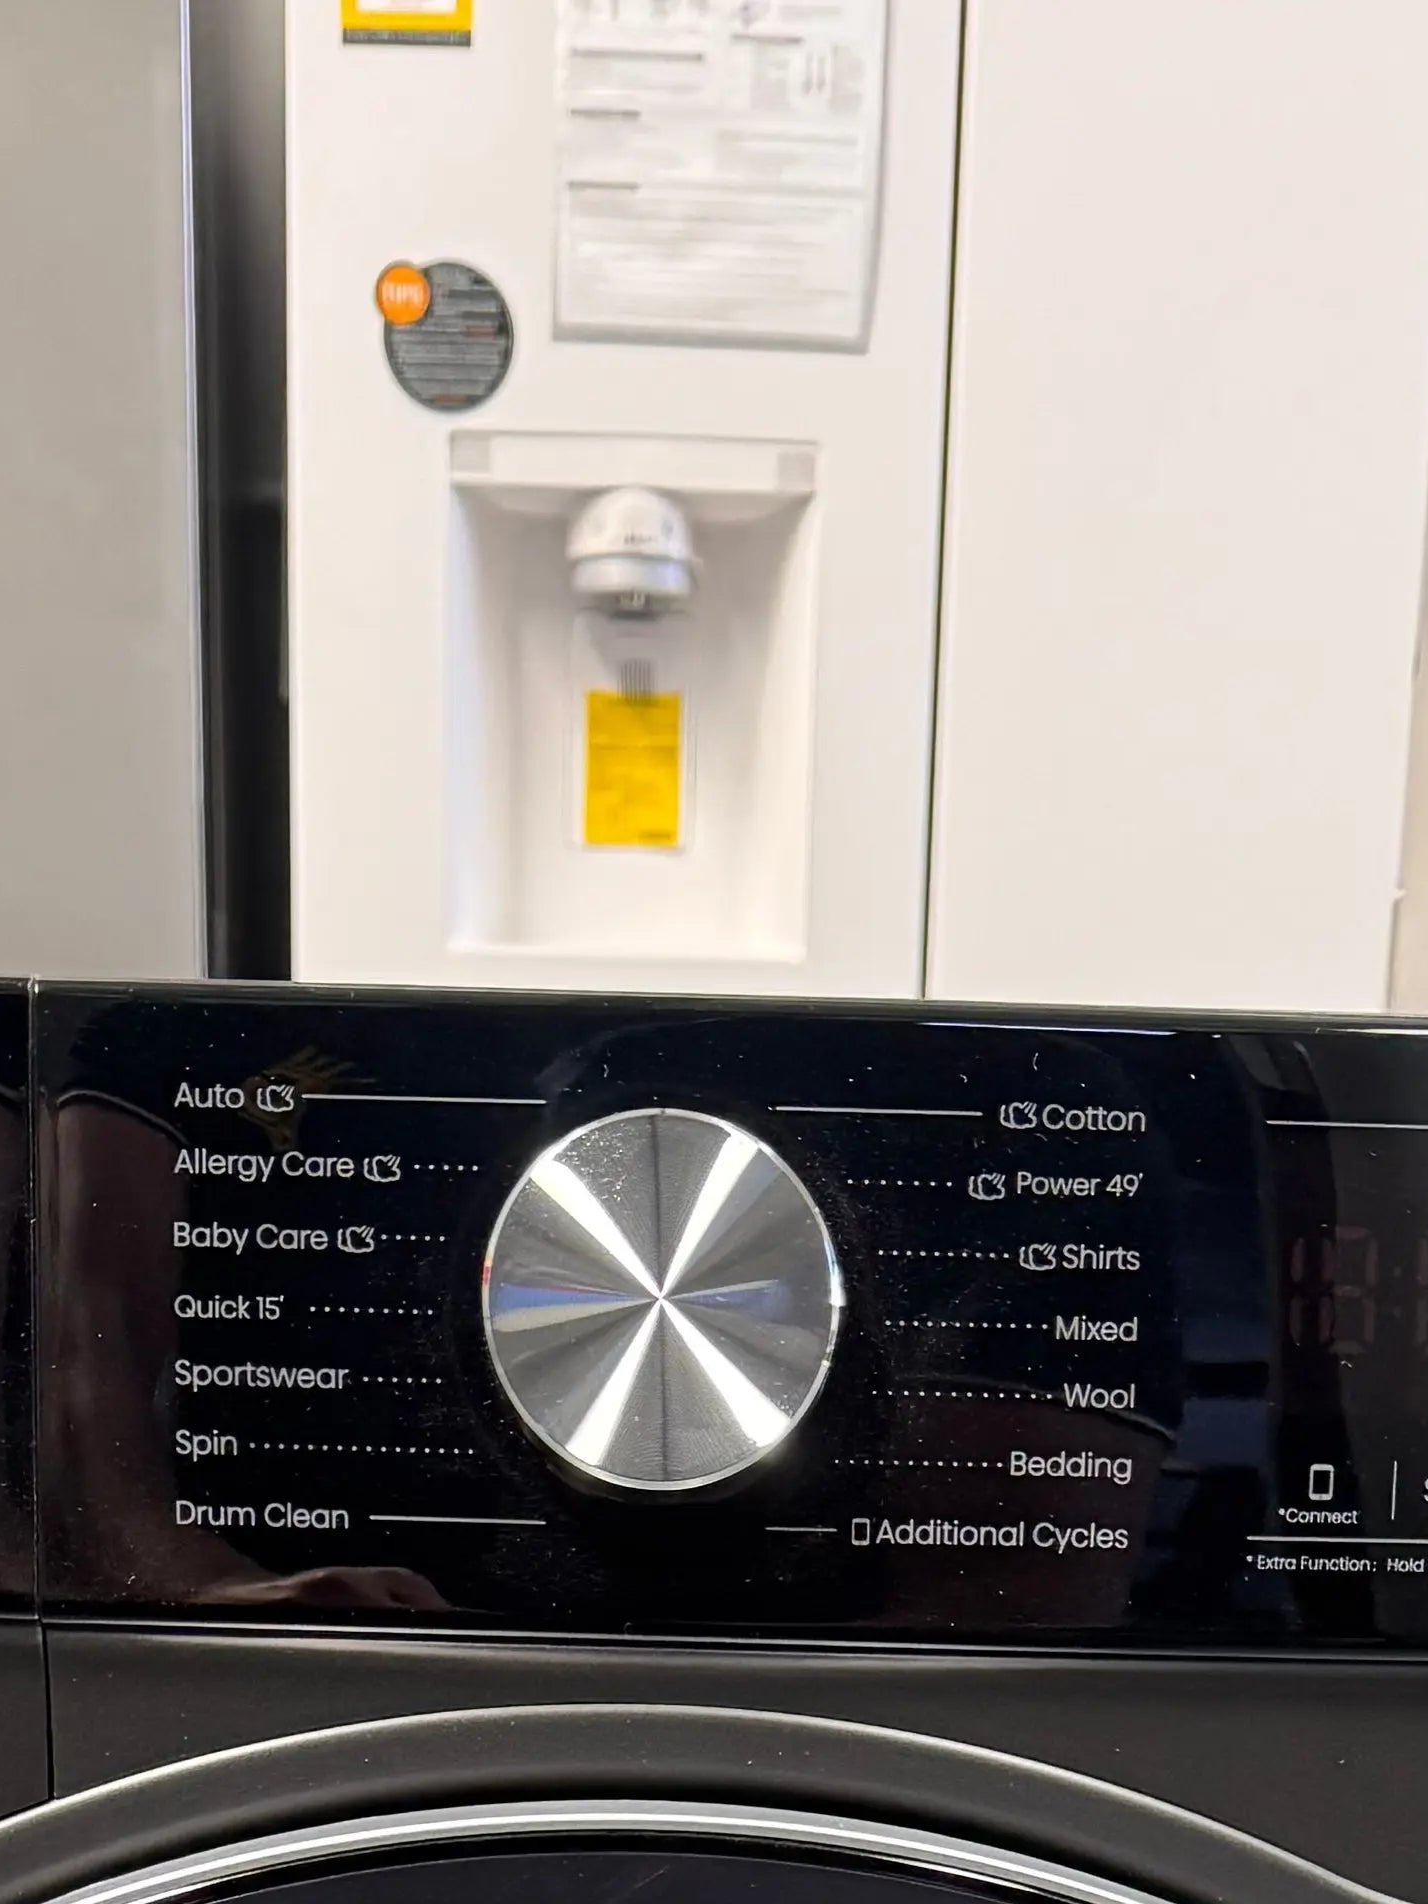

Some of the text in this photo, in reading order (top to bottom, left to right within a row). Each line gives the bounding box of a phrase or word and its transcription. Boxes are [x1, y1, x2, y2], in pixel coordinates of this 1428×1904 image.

[174, 1083, 245, 1108] Auto
[1042, 1104, 1146, 1133] Cotton
[174, 1151, 354, 1182] Allergy Care
[1017, 1172, 1143, 1198] Power 49'
[173, 1222, 328, 1255] Baby Care
[1062, 1244, 1140, 1271] Shirts
[174, 1295, 285, 1320] Quick 15'
[1055, 1316, 1138, 1342] Mixed
[174, 1360, 349, 1392] Sportswear
[1064, 1383, 1136, 1409] Wool
[175, 1430, 238, 1461] Spin
[1010, 1451, 1133, 1484] Bedding
[175, 1501, 349, 1529] Drum Clean
[876, 1519, 1129, 1554] Additional Cycles
[1301, 1556, 1377, 1572] Function:
[1387, 1558, 1424, 1573] Hold
